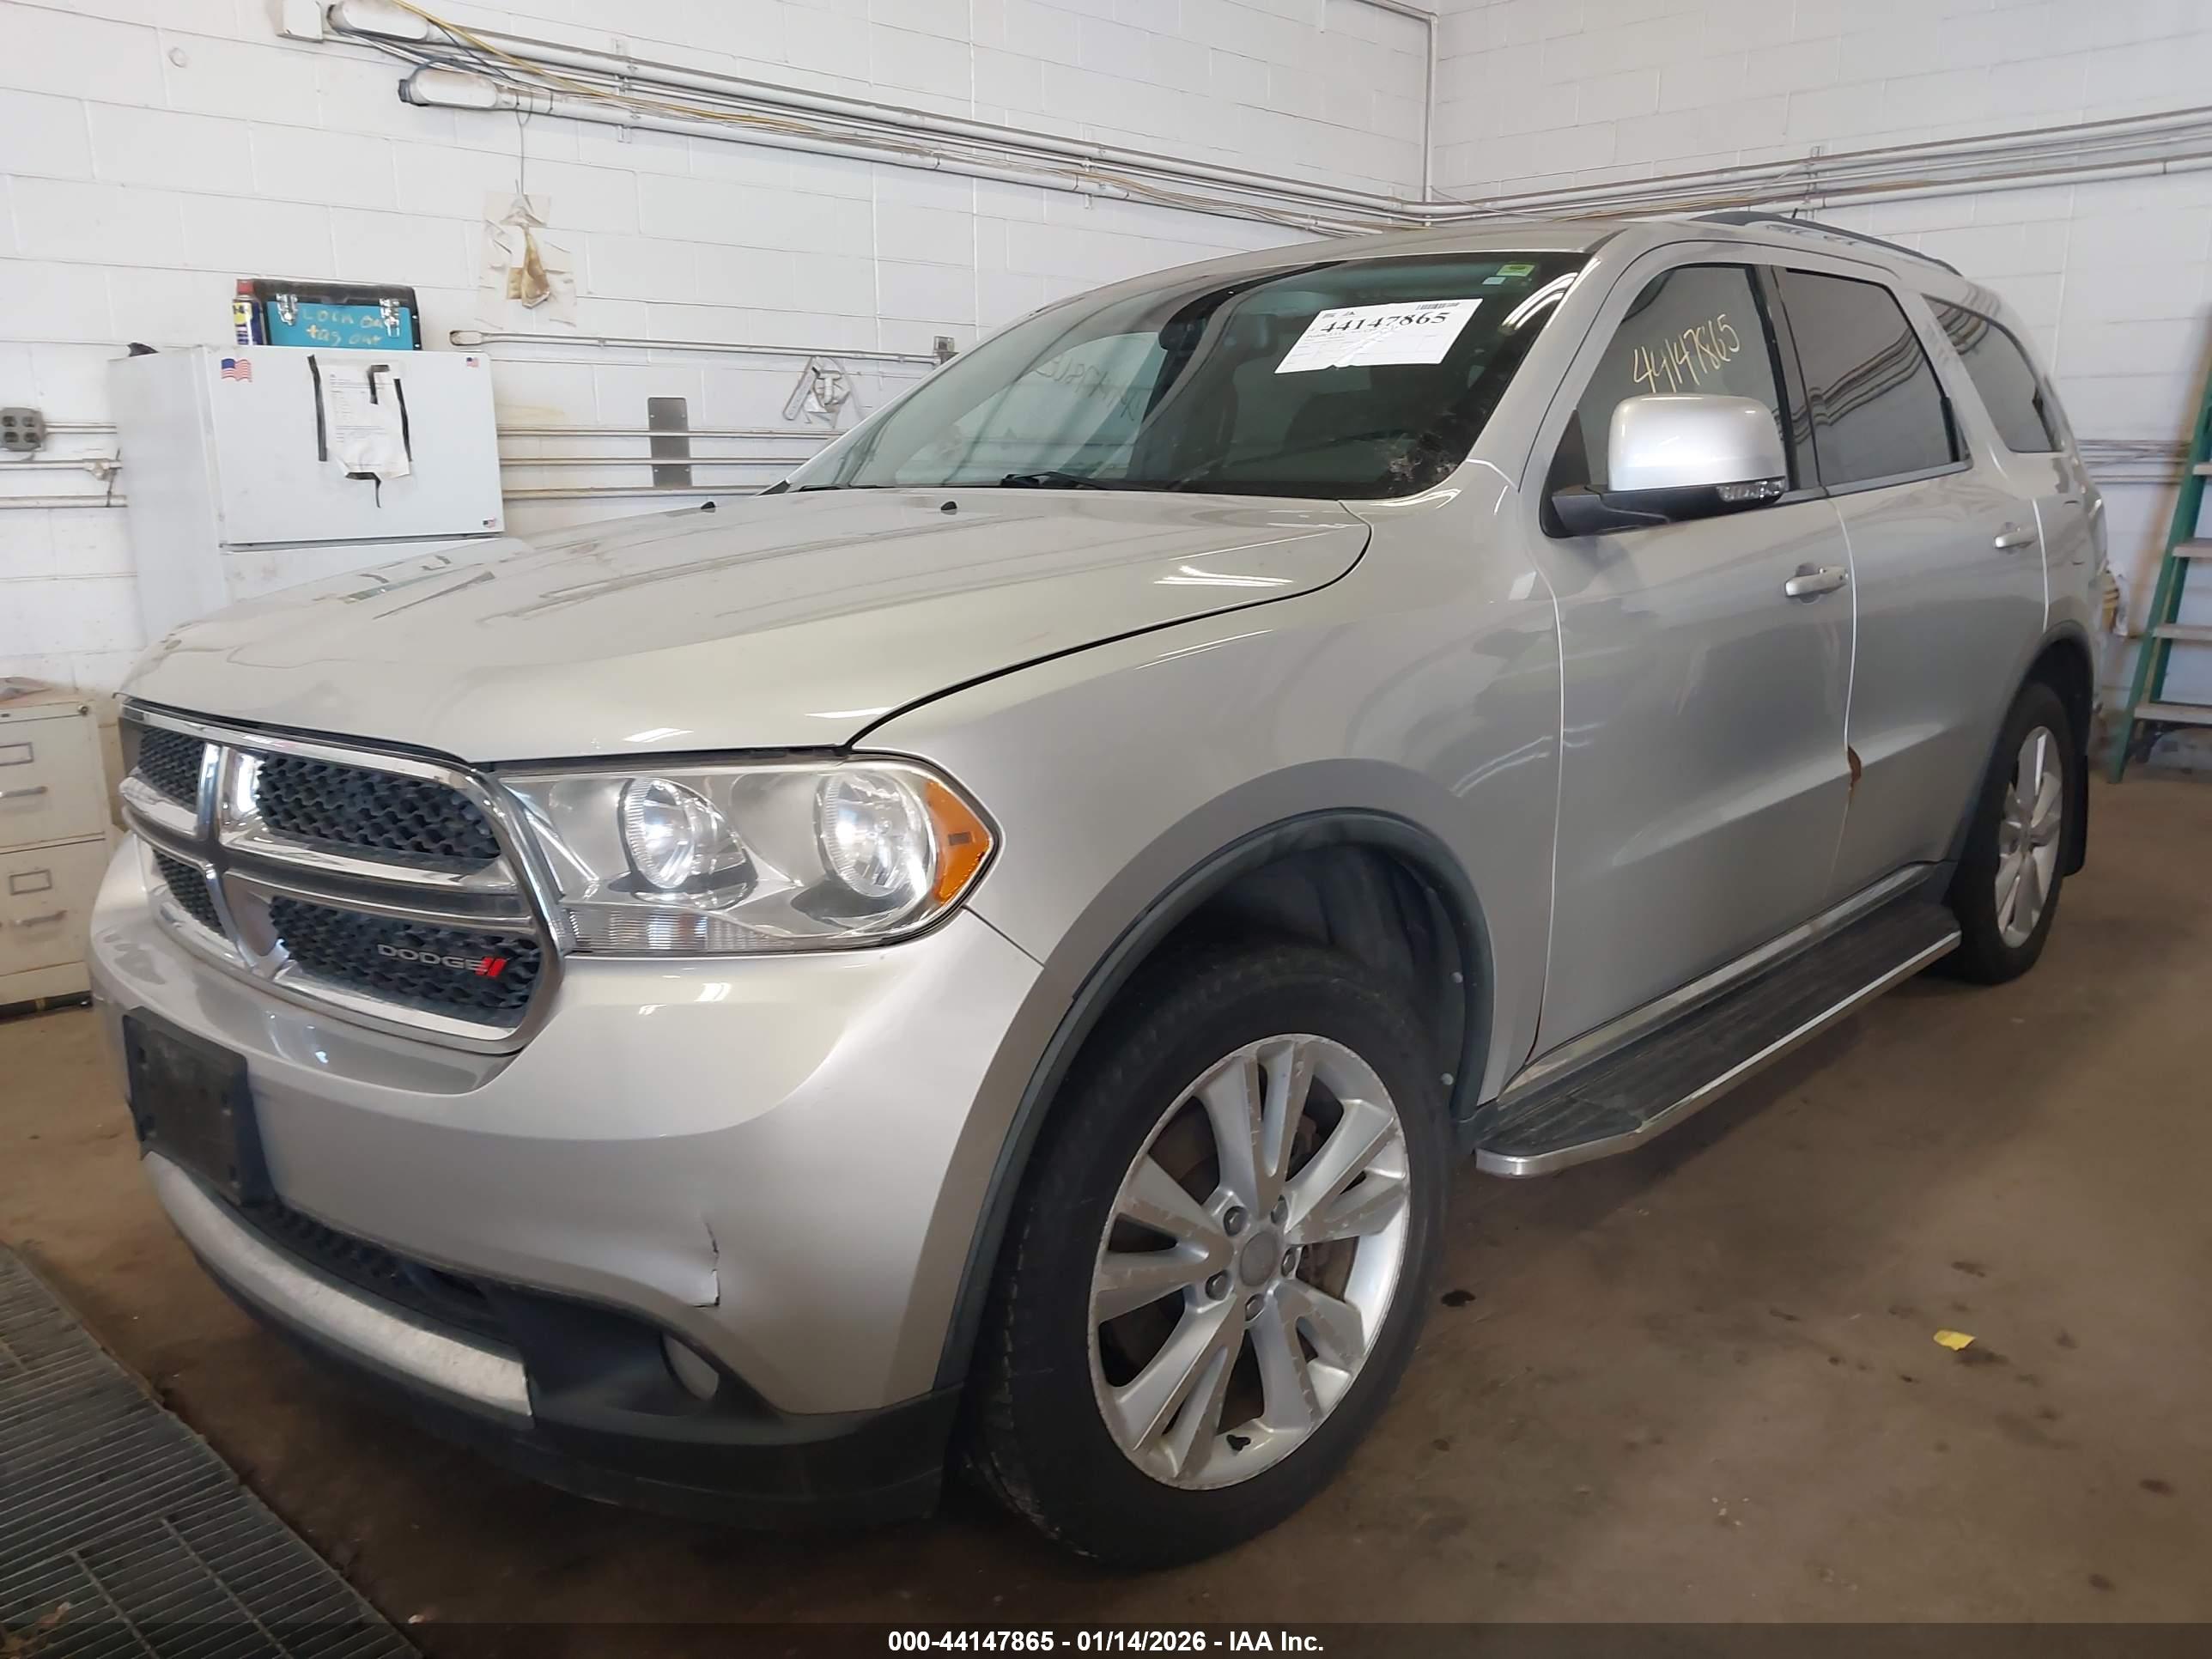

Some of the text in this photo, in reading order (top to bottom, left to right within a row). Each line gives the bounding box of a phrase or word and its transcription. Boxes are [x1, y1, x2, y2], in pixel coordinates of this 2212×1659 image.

[1320, 311, 1452, 333] 44147865
[1632, 313, 1740, 393] 44147865
[376, 944, 488, 974] DODGE
